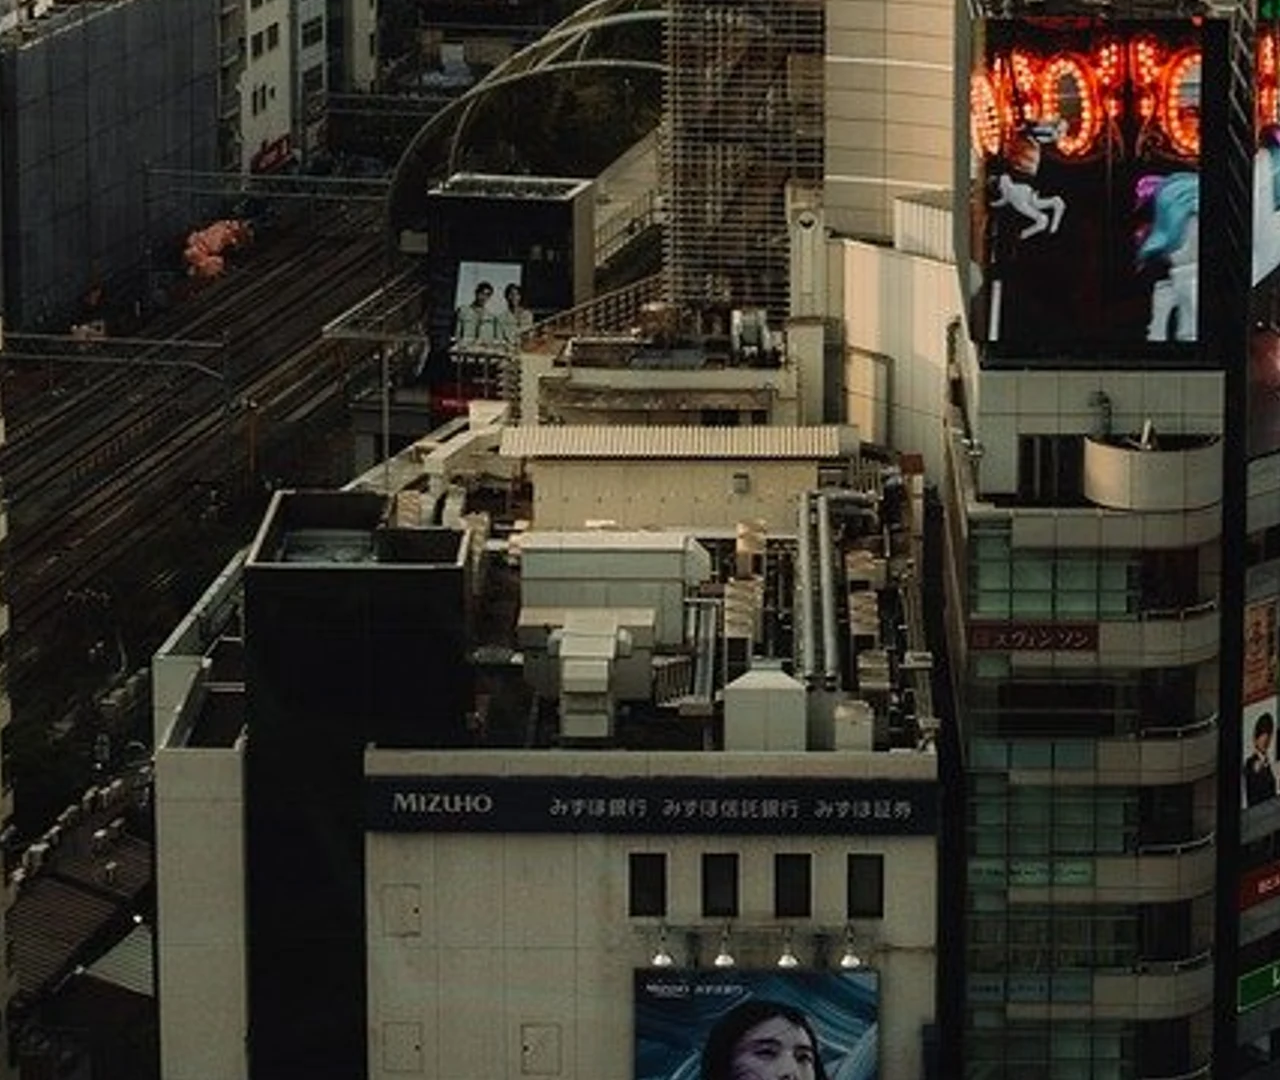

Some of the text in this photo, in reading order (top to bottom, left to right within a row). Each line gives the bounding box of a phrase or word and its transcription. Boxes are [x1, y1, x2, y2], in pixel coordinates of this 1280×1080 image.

[393, 792, 493, 814] MIZUHO
[548, 796, 647, 818] みずほ銀行
